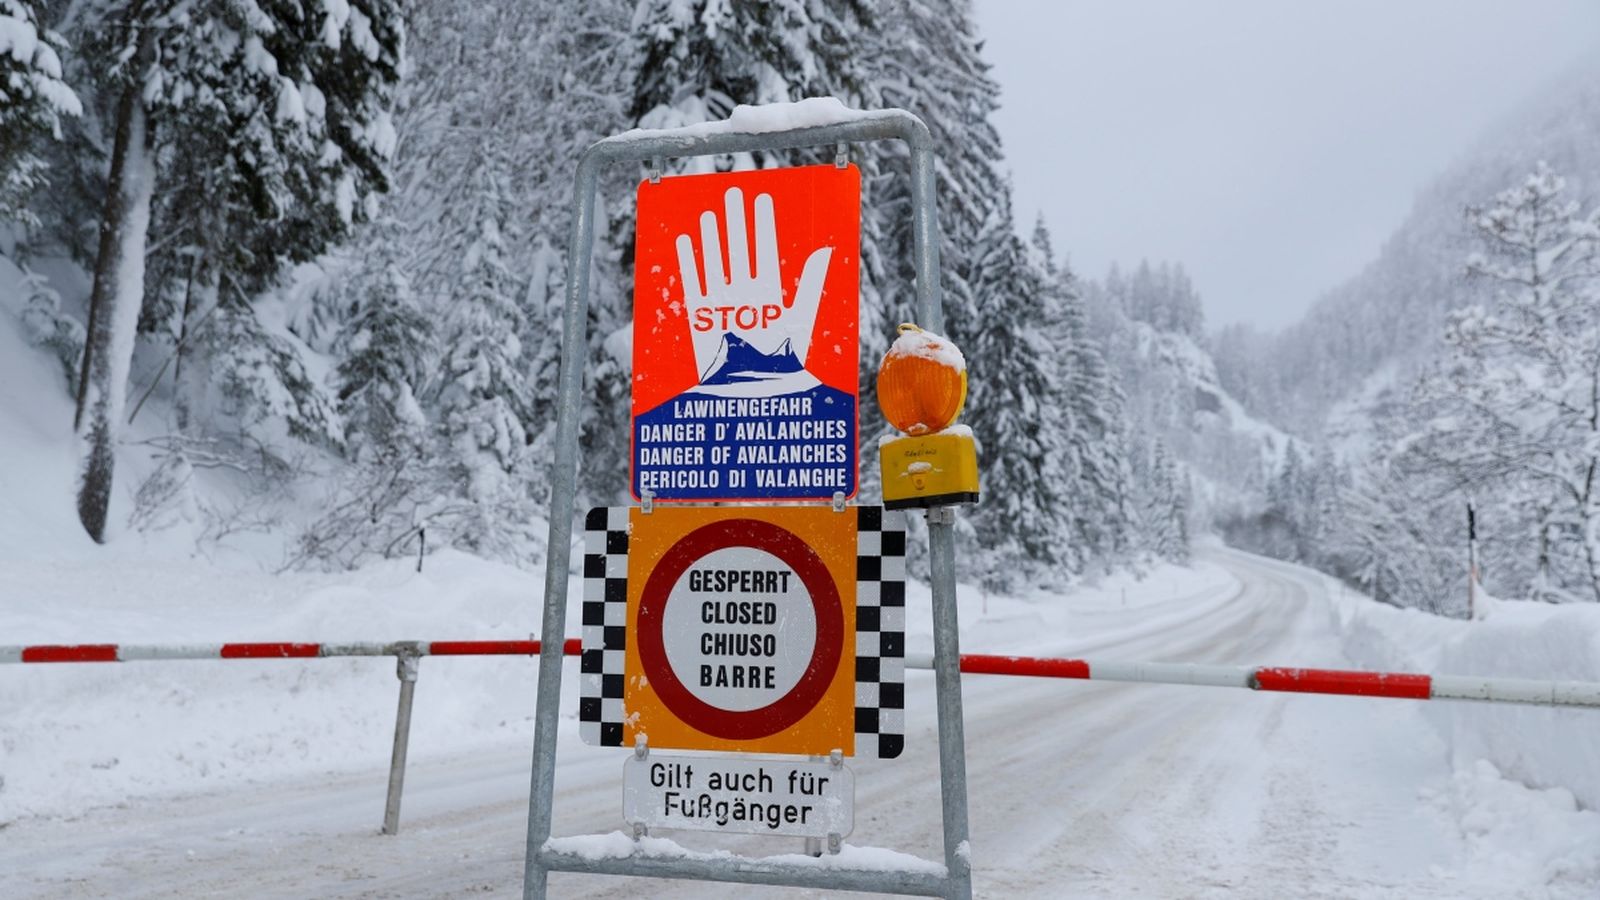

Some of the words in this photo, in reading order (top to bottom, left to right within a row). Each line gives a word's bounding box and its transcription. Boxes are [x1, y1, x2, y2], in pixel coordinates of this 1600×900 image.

[693, 304, 782, 331] STOP
[674, 397, 812, 419] LAWINENGEFAHR
[640, 423, 705, 442] DANGER
[715, 422, 730, 441] D'
[735, 420, 847, 440] AVALANCHES
[640, 447, 704, 465] DANGER
[711, 446, 731, 465] OF
[737, 444, 847, 464] AVALANCHES
[640, 470, 719, 488] PERICOLO
[729, 469, 746, 488] DI
[755, 468, 846, 487] VALANGHE
[689, 569, 791, 593] GESPERRT
[701, 601, 777, 625] CLOSED
[700, 632, 776, 657] CHIUSO
[700, 664, 775, 689] BARRE
[650, 762, 693, 789] Gilt
[708, 768, 773, 793] auch
[788, 770, 829, 796] für
[664, 791, 813, 829] Fußgänger
